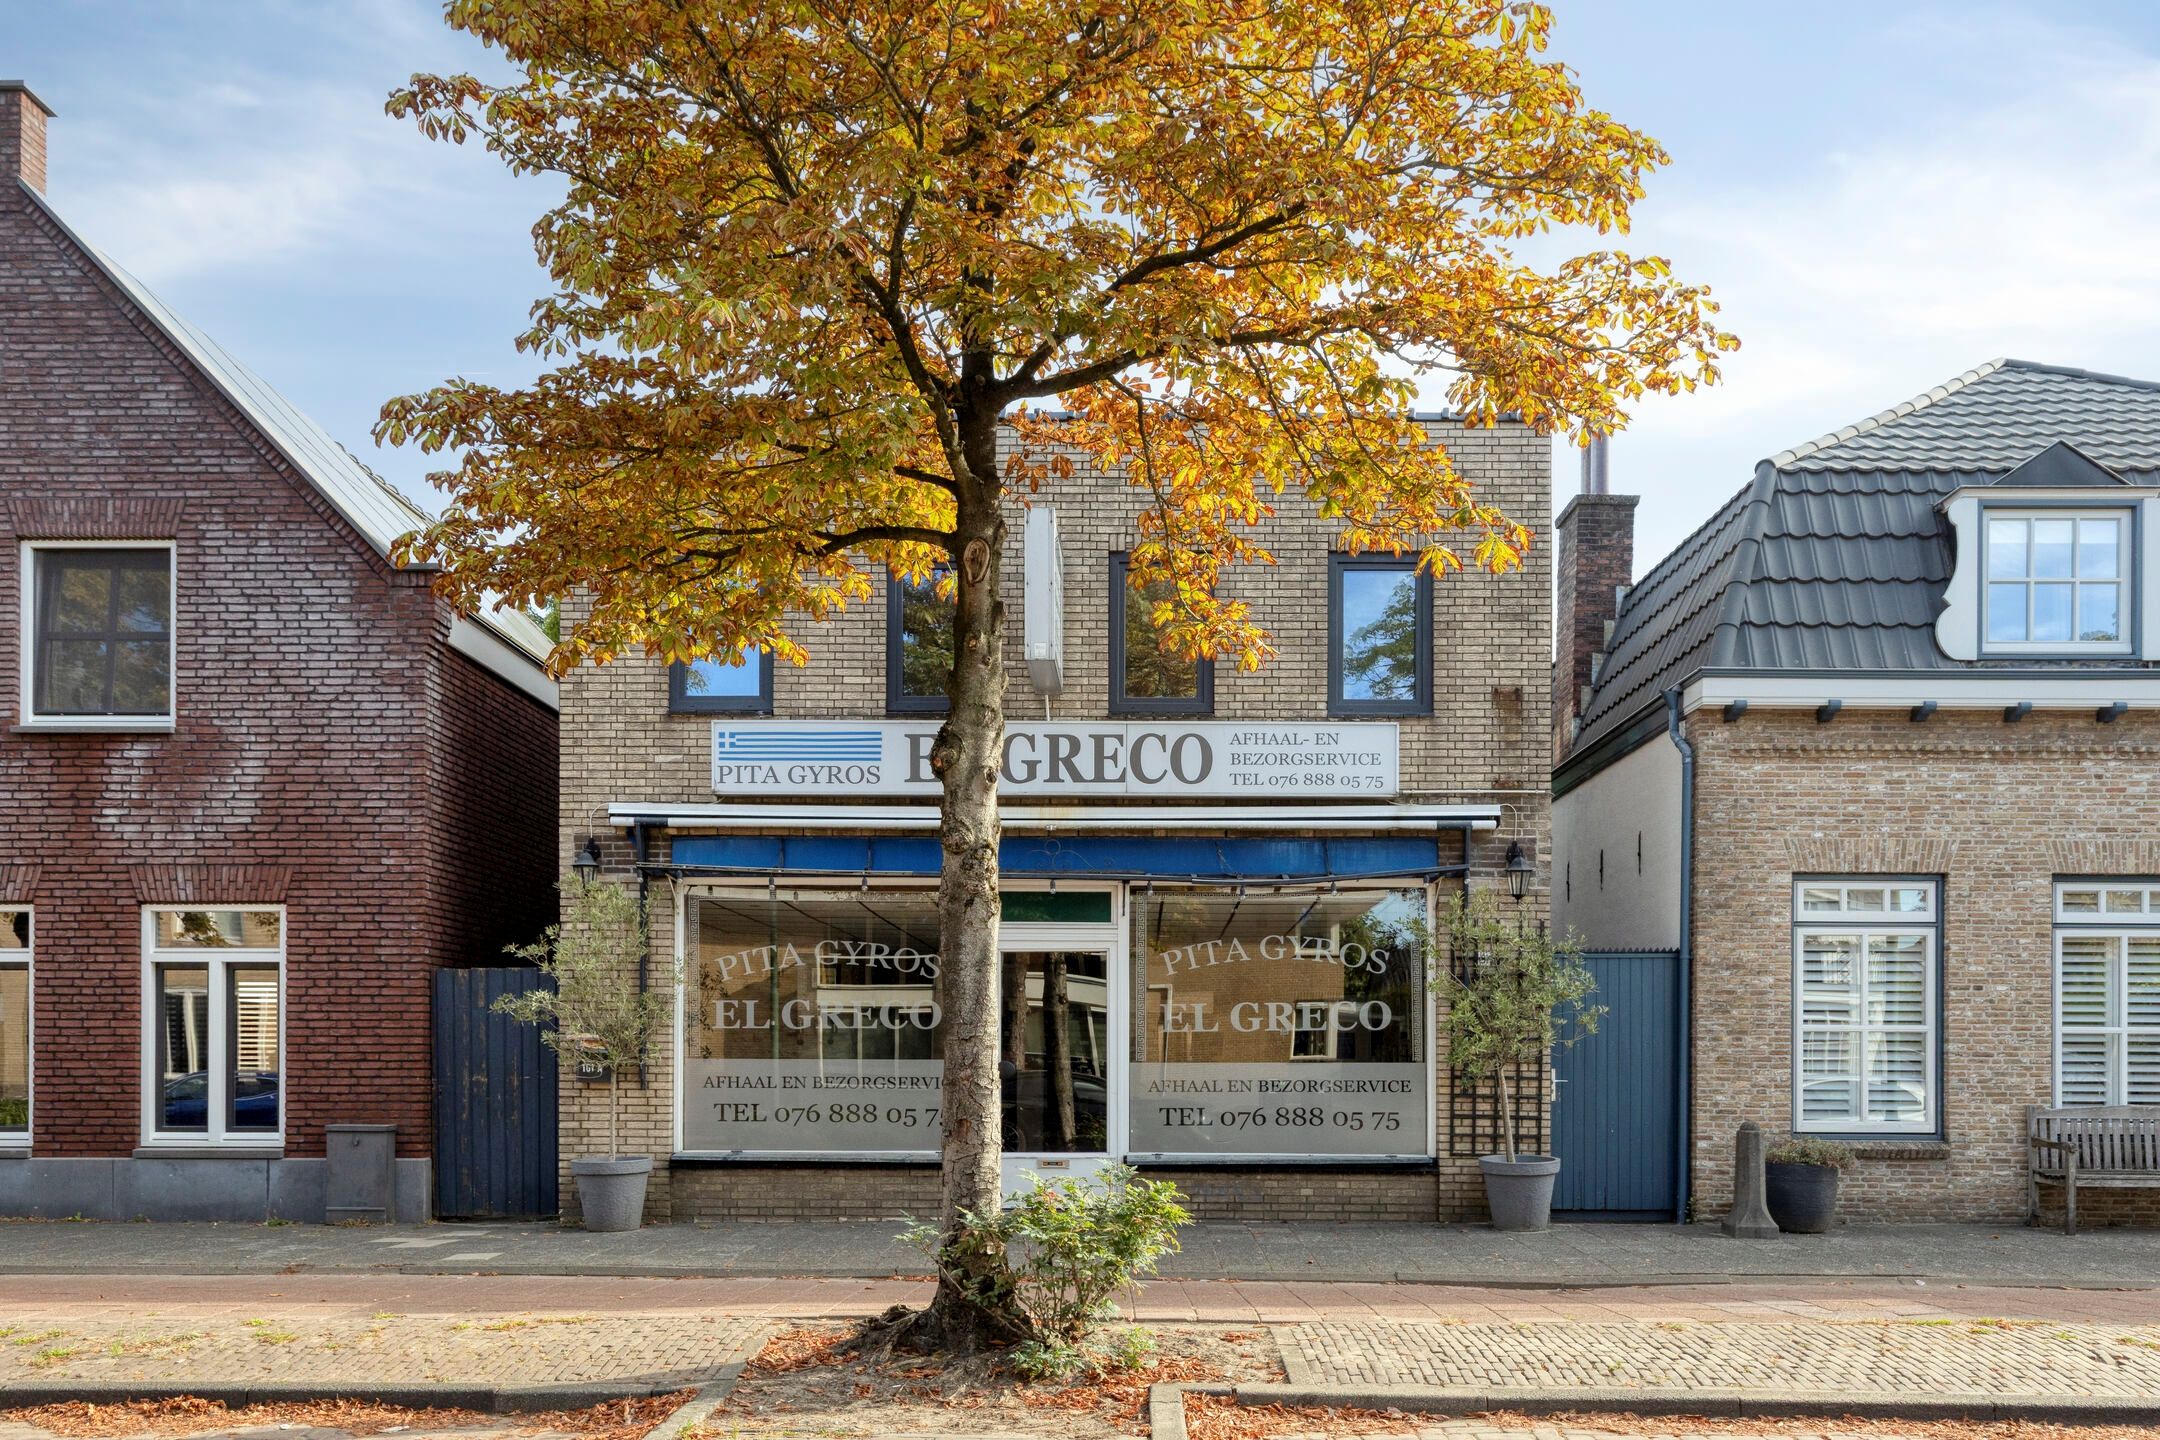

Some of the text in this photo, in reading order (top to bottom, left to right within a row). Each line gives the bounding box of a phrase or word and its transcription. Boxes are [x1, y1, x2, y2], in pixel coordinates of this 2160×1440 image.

[1229, 732, 1341, 746] AFHAAL- EN
[1000, 732, 1214, 785] GRECO
[1230, 752, 1382, 766] BEZORGSERVICE
[717, 764, 881, 785] PITA GYROS
[1229, 772, 1384, 789] TEL 076 888 05 75
[714, 939, 942, 983] PITA GYROS
[1160, 934, 1390, 977] PITA GYROS
[712, 999, 943, 1030] EL GRECO
[1161, 1000, 1393, 1033] EL GRECO
[703, 1075, 944, 1090] AFHAAL EN BEZORGSERVI
[1148, 1079, 1412, 1093] AFHAAL EN BEZORGSERVICE
[714, 1103, 943, 1128] TEL 076 888 05 7
[1159, 1106, 1401, 1131] TEL 076 888 05 75
